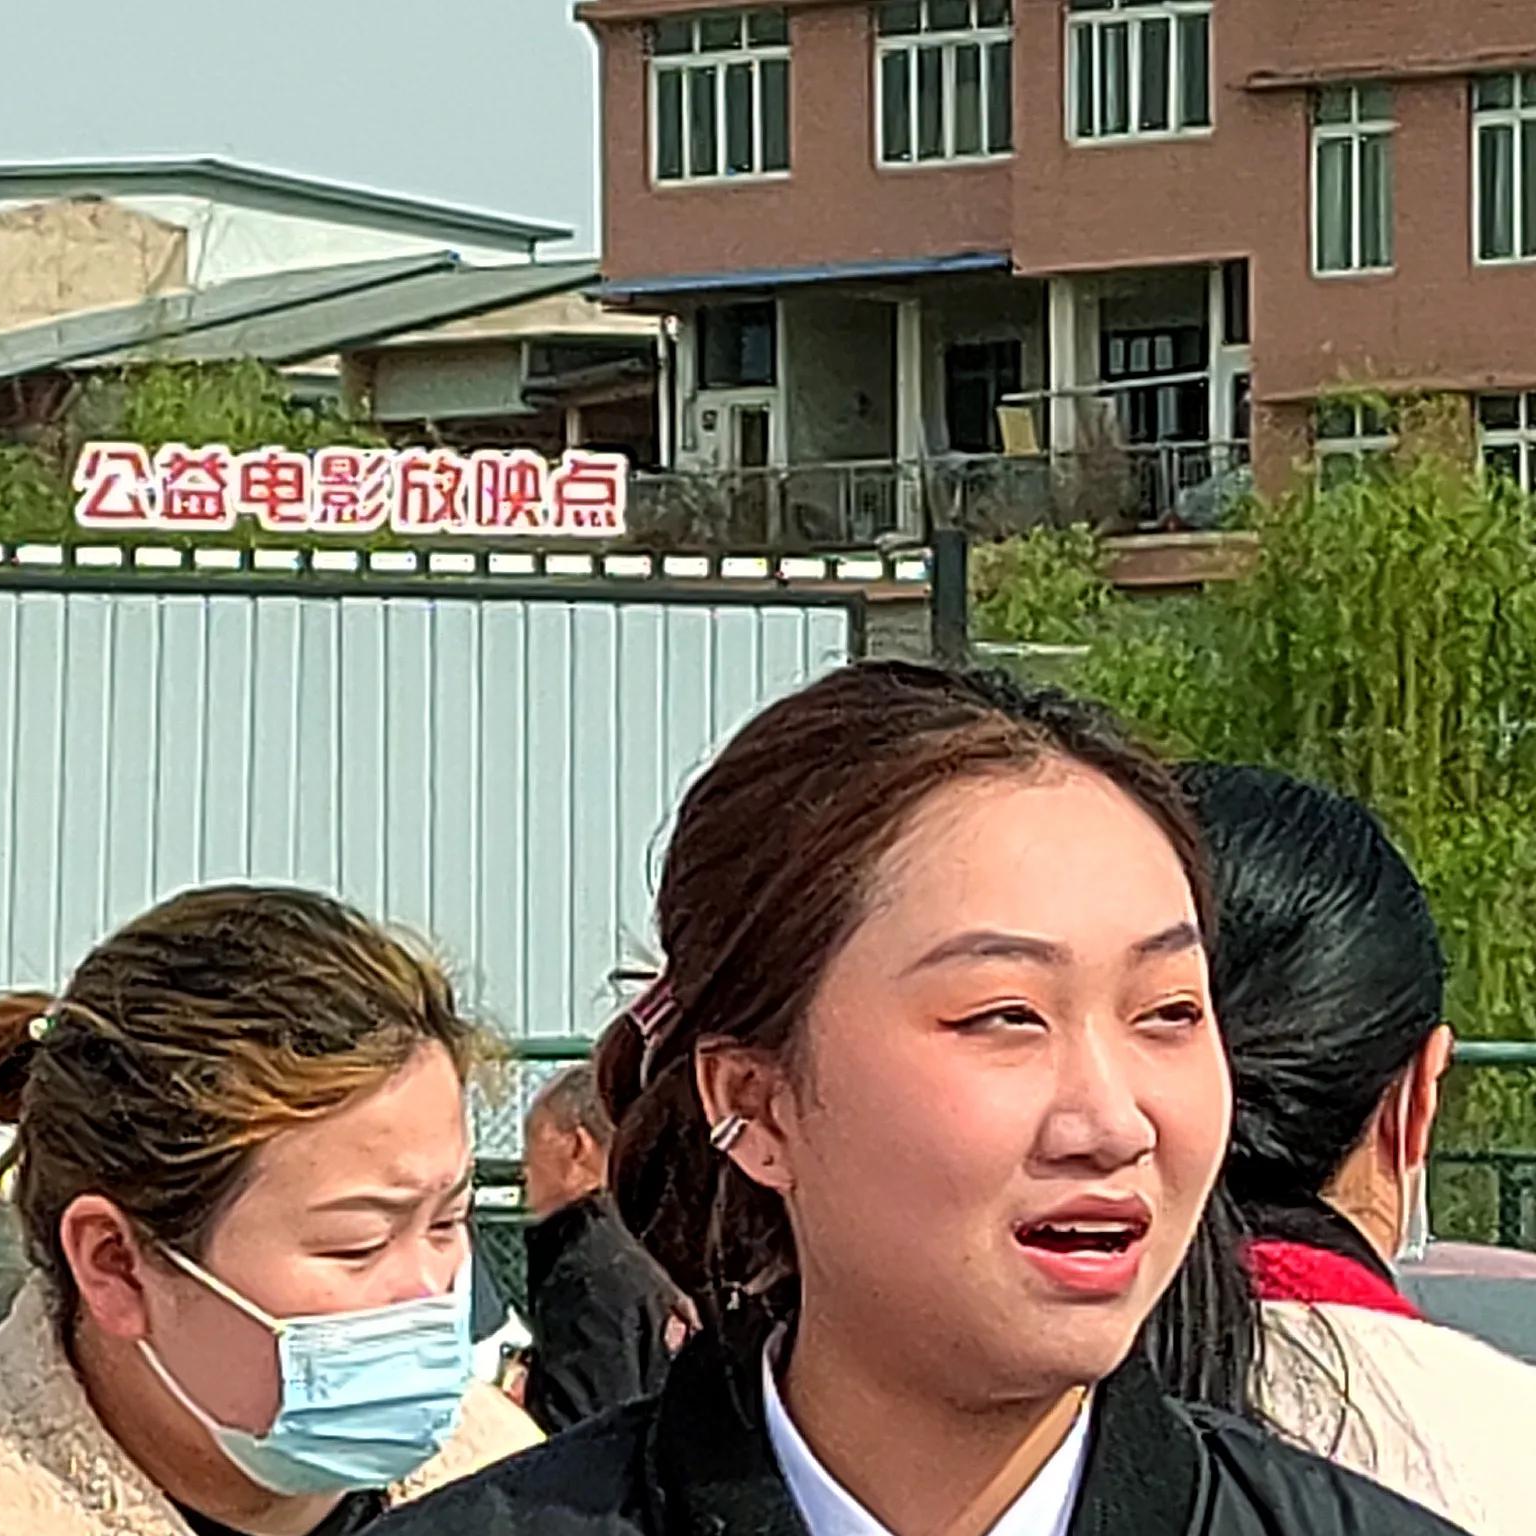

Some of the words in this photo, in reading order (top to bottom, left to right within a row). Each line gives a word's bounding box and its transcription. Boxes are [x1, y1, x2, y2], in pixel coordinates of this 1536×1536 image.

[77, 443, 624, 530] 公益电影放映点
